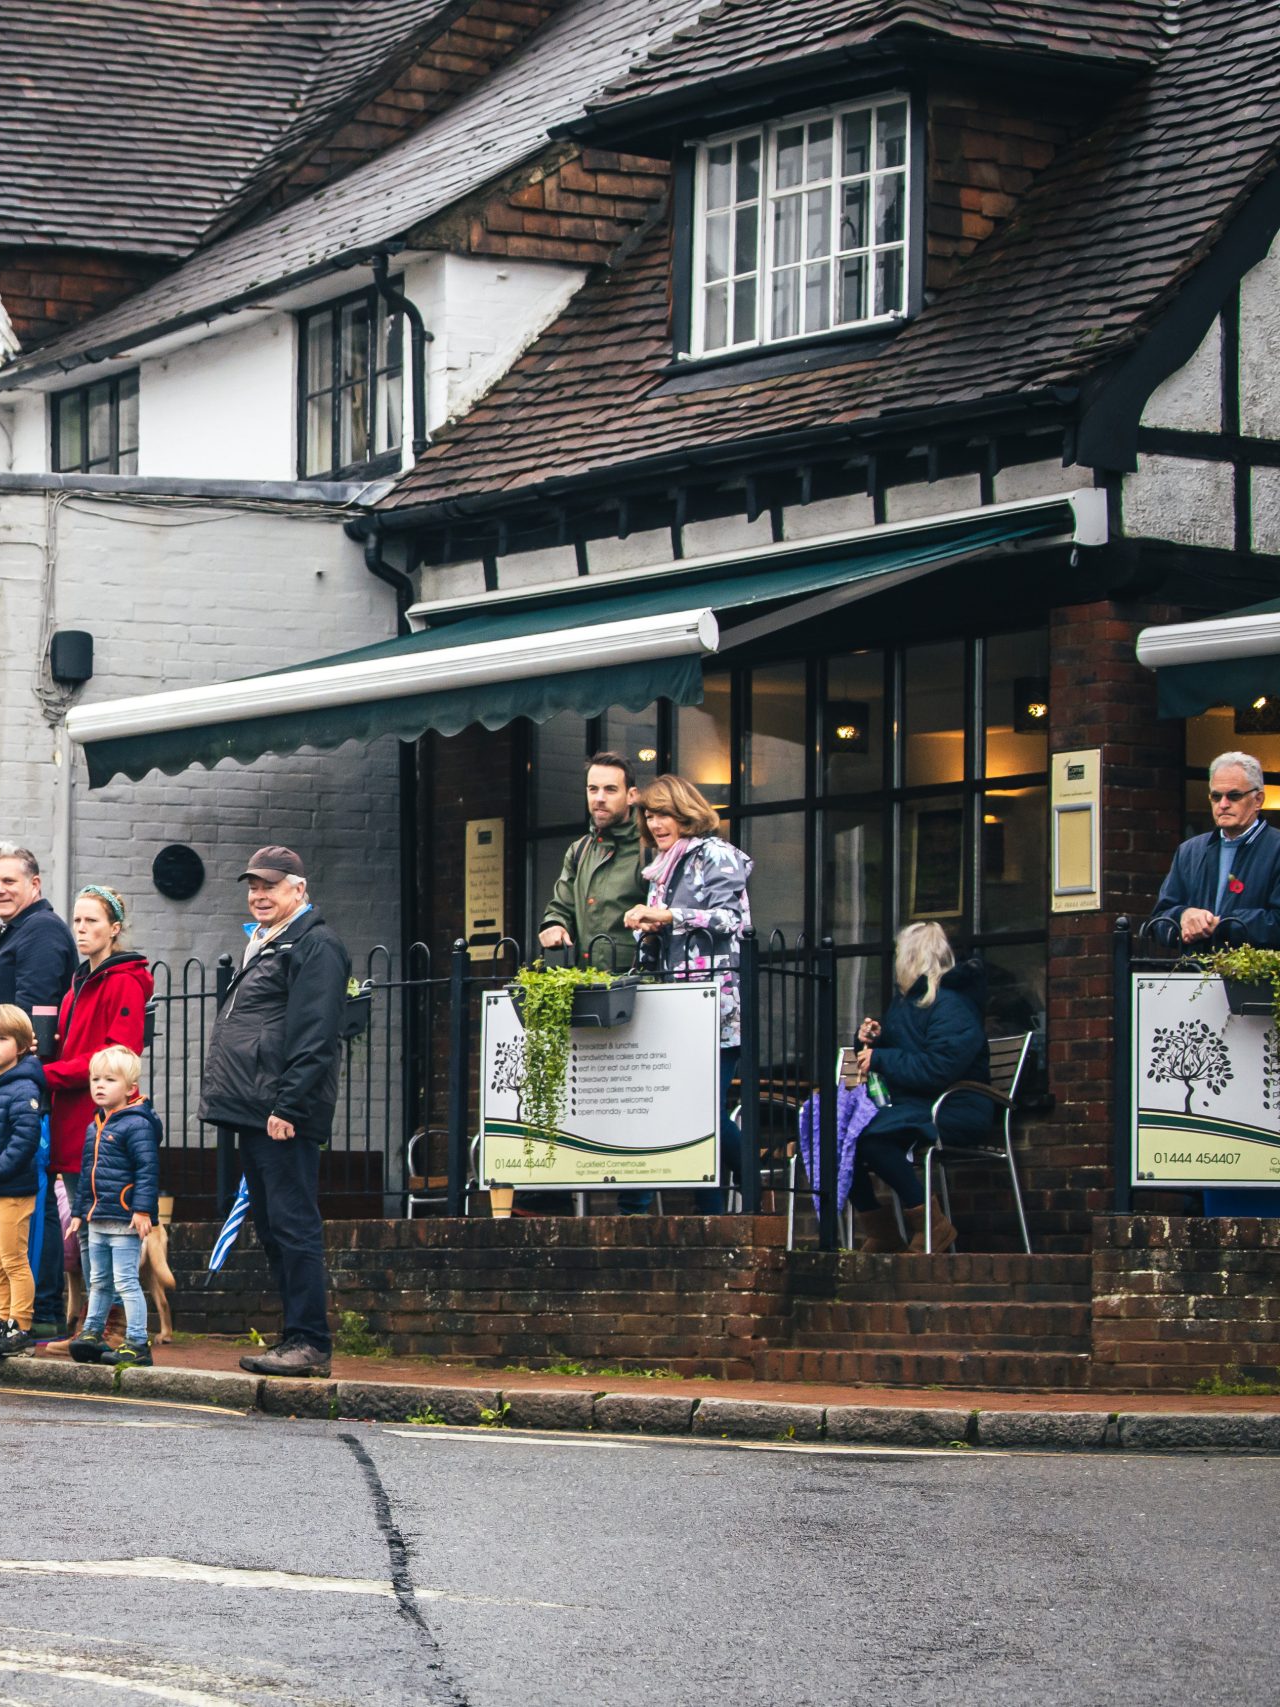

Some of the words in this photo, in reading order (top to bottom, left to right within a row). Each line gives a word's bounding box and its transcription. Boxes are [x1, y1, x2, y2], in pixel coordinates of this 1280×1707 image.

[615, 1042, 639, 1050] lunches
[579, 1053, 614, 1062] sandwiches
[616, 1053, 635, 1061] cakes
[635, 1052, 648, 1060] and
[649, 1052, 667, 1060] drinks
[607, 1064, 618, 1072] eat
[652, 1062, 672, 1071] patio)
[578, 1076, 609, 1084] takeaway
[610, 1075, 633, 1083] service
[578, 1087, 605, 1095] bespoke
[578, 1098, 599, 1106] phone
[599, 1097, 619, 1105] orders
[620, 1096, 654, 1104] welcomed
[596, 1108, 622, 1117] monday
[627, 1107, 650, 1115] sunday
[576, 1160, 605, 1168] Cuckfield
[607, 1159, 646, 1168] Cornerhouse
[1153, 1152, 1192, 1165] 01444
[1196, 1152, 1241, 1165] 454407
[494, 1158, 522, 1170] 01444
